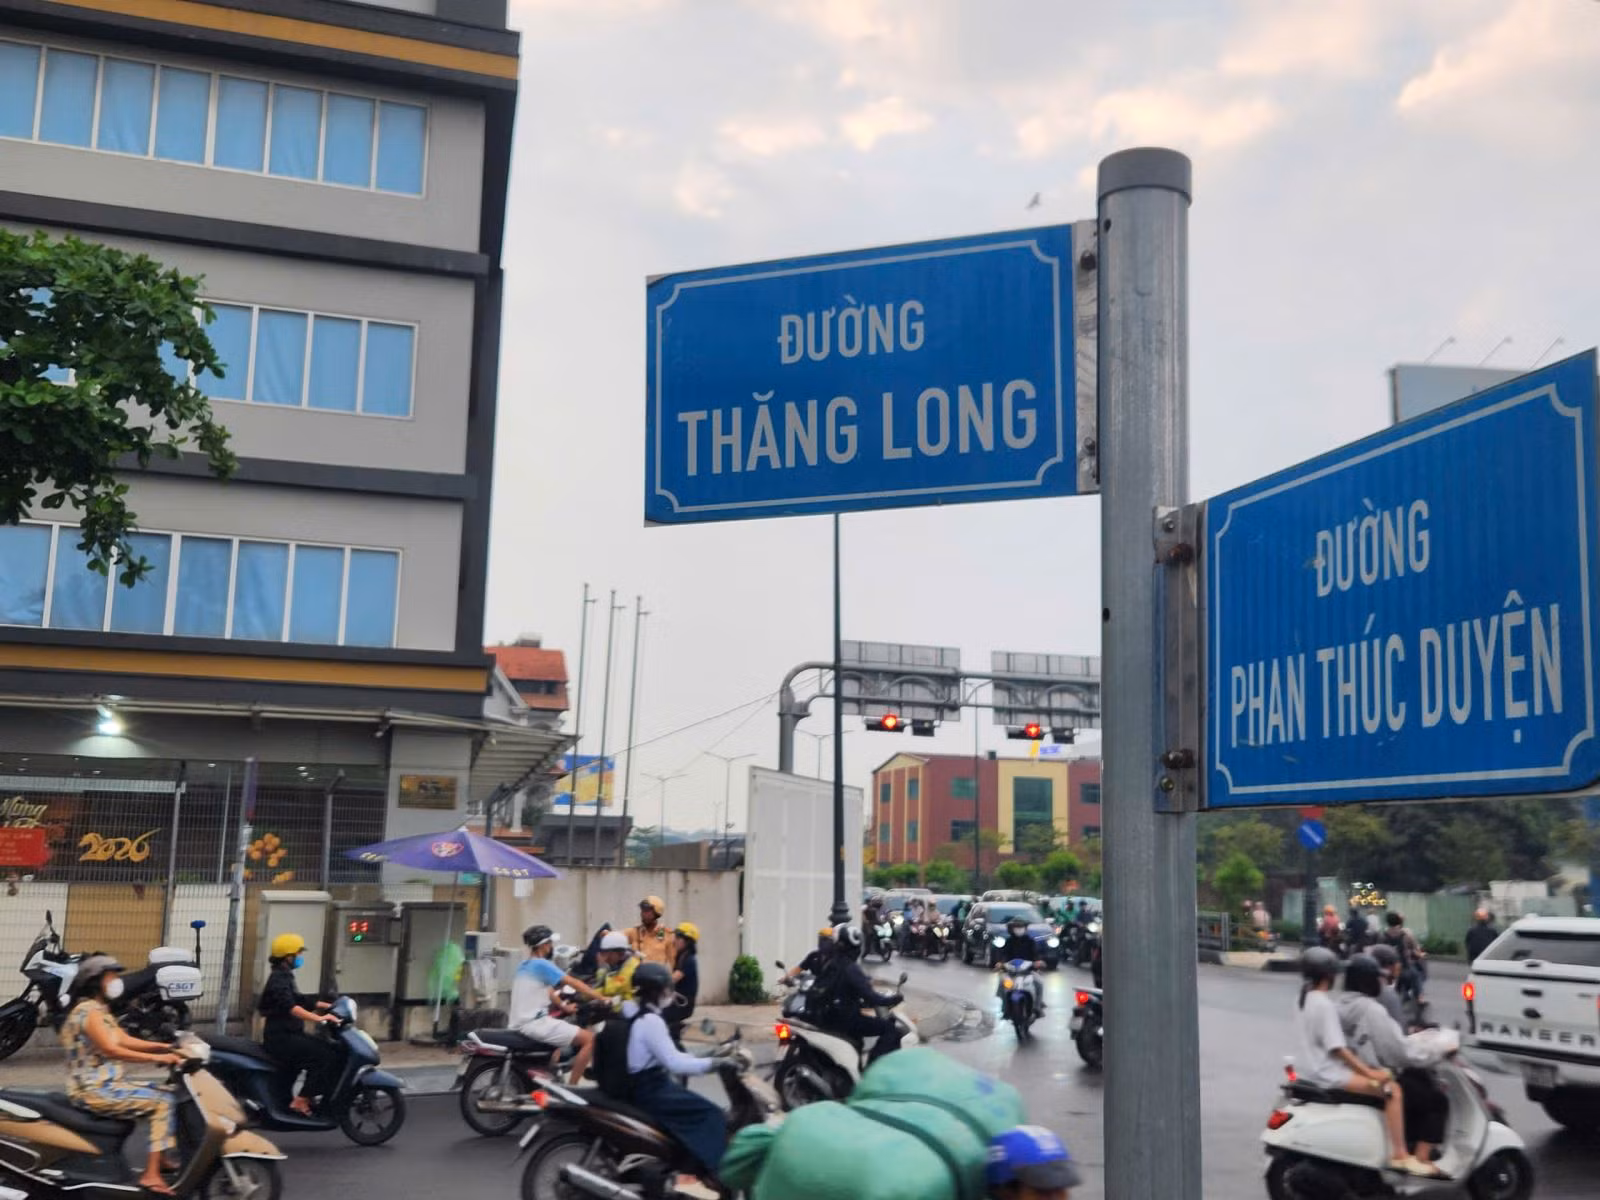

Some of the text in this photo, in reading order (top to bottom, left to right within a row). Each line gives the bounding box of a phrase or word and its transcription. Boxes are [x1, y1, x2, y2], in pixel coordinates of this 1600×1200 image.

[777, 294, 925, 365] ĐƯỜNG
[677, 379, 1038, 477] THĂNG LONG
[1314, 498, 1430, 597] ĐƯỜNG
[1231, 589, 1563, 748] PHAN THÚC DUYỆN
[78, 827, 162, 863] 2026
[1480, 1021, 1596, 1047] RANGER
